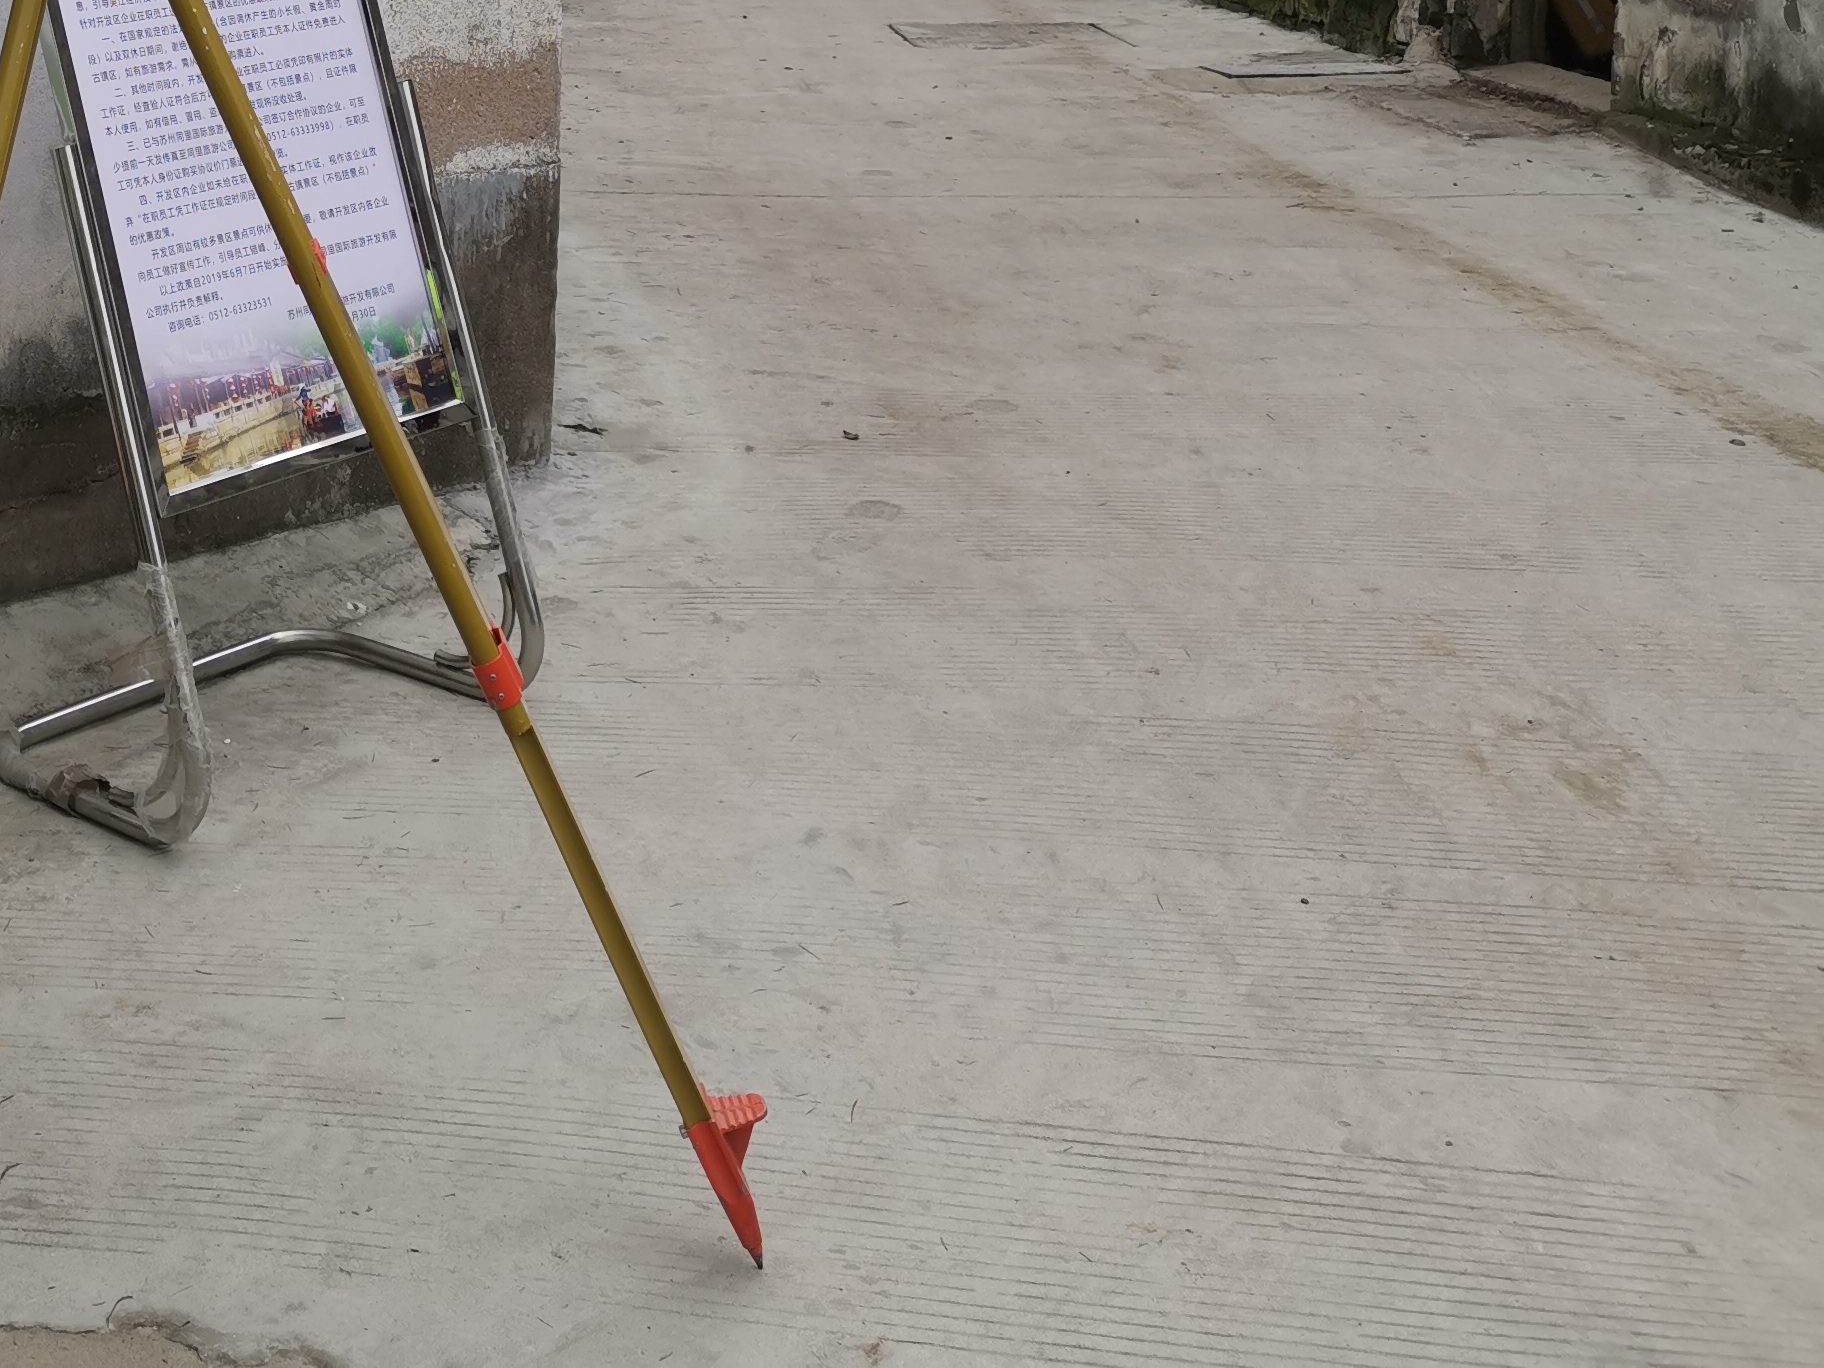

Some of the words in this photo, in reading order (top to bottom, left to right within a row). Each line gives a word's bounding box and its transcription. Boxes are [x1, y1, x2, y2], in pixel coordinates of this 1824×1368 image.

[86, 13, 346, 66] 段）以及双休日期间，谢绝的企业在职员工凭本人证件免费进入
[90, 45, 265, 84] 古镇区，如有旅游需求，需从购票进入。
[99, 63, 358, 120] 工作证，经查验人证符合后方景区（不包括景点），且证件限
[112, 46, 353, 99] 二、其他时间段内，开发业在职员工必须凭印有照片的实体
[111, 112, 369, 175] 少提前一天发传真至同里旅游公司0512-63333998），在职员
[125, 95, 365, 152] 三、已与苏州同里国际旅游司签订合作协议的企业，可至
[115, 147, 289, 192] 工可凭本人身份证购买协议价门票进览。
[137, 145, 377, 207] 四、开发区内企业如未给在职实体工作证，视作该企业放
[158, 228, 397, 297] 以上政策自2019年6月7日开始实施同里国际旅游开发有限
[286, 282, 396, 321] 苏州同游开发有限公司
